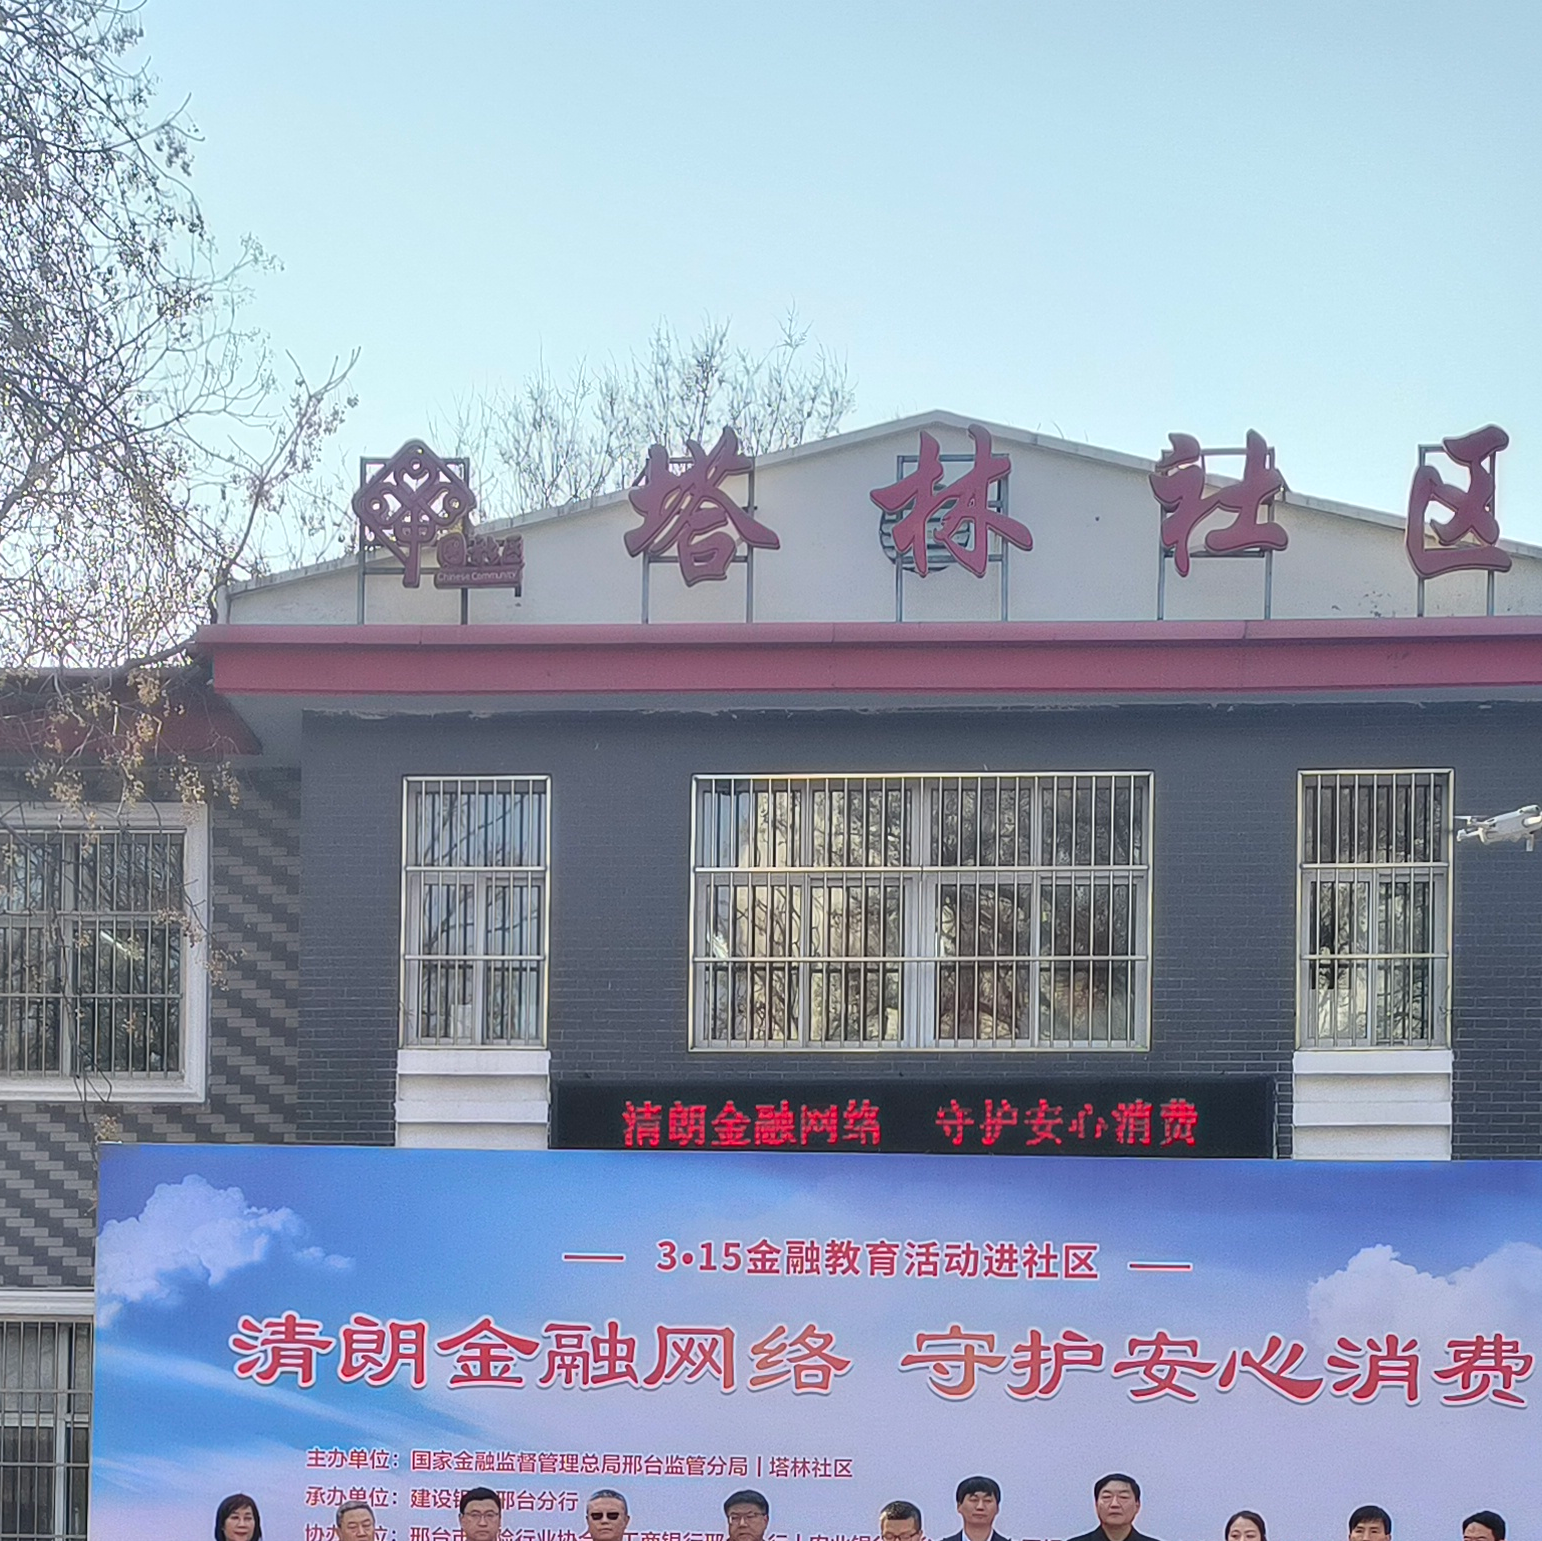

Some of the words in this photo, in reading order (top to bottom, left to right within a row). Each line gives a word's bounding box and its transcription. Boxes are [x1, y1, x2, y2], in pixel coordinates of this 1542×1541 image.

[624, 425, 1512, 586] 塔林社区
[621, 1099, 882, 1146] 清朗金融网络
[935, 1098, 1199, 1147] 守护安心消费
[232, 1313, 851, 1394] 清朗金融网络
[901, 1325, 1533, 1405] 守护安心消费
